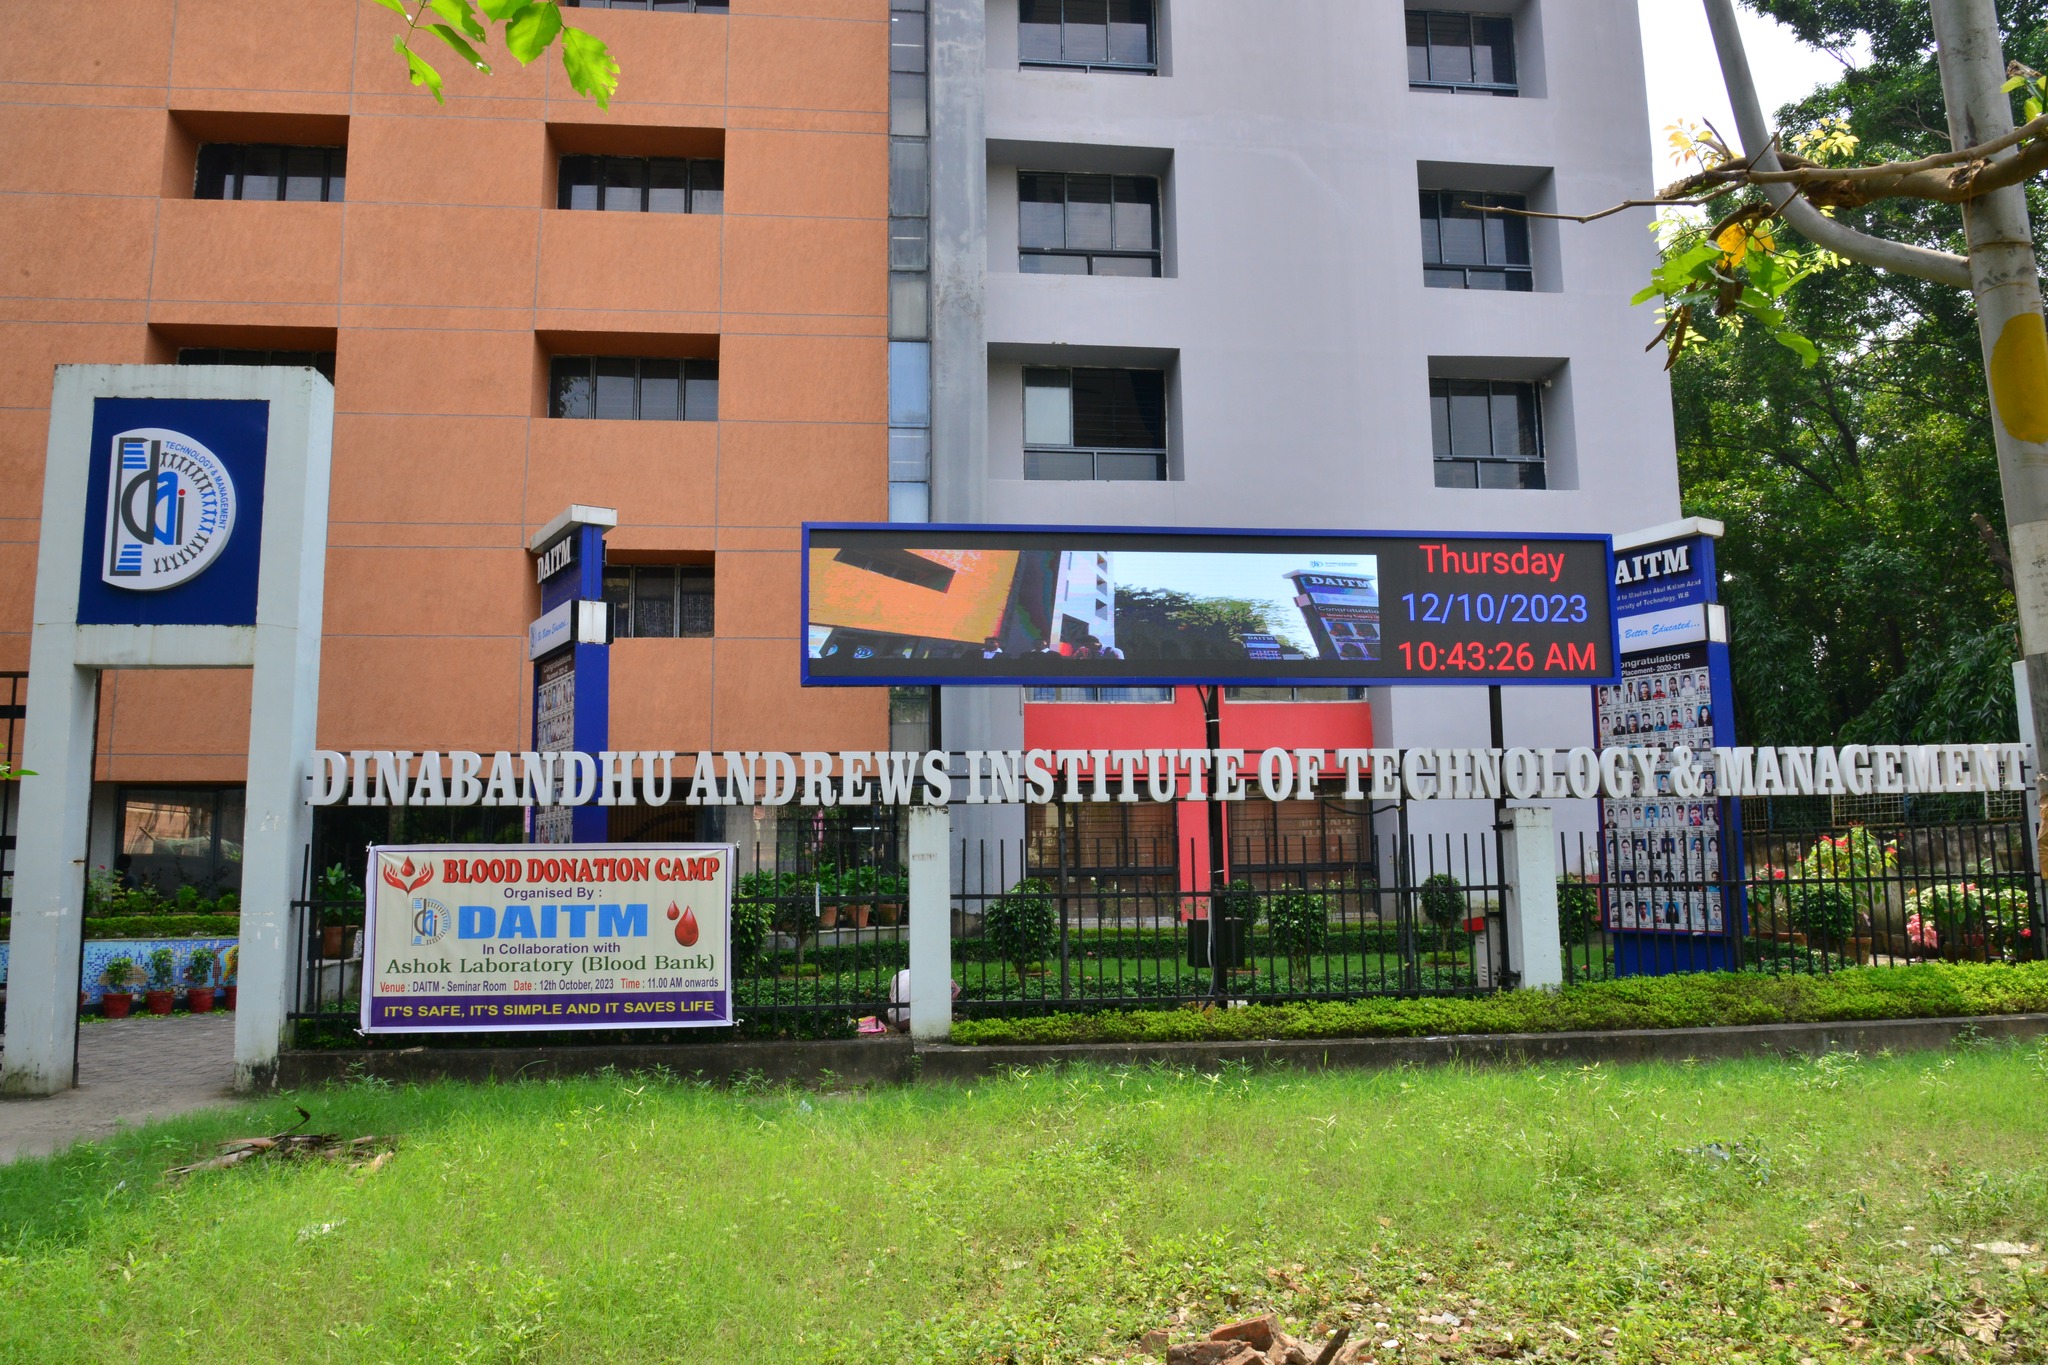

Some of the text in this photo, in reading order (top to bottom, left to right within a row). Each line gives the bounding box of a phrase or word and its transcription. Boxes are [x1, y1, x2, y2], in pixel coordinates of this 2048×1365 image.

[165, 440, 215, 469] TECHNOLOGY
[214, 475, 229, 530] MANAGEMENT
[537, 536, 572, 584] DAITM
[1419, 544, 1565, 582] Thursday
[1615, 545, 1690, 585] AITM
[1310, 576, 1369, 589] DAITM
[1628, 589, 1652, 599] Maulana
[1652, 586, 1666, 594] Abul
[1666, 583, 1686, 591] Kalam
[1686, 579, 1701, 587] Azad
[1402, 592, 1588, 624] 12/10/2023
[1617, 602, 1635, 611] versity
[1625, 620, 1700, 639] Better Educated...
[1398, 641, 1596, 671] 10:43:26 AM
[1621, 652, 1691, 670] ongratulations
[1656, 662, 1681, 671] 2020-21
[308, 743, 2028, 806] DINABANDHU ANDREWS INSTITUTE OF TECHNOLOGY & MANAGEMENT
[442, 857, 720, 883] BLOOD DONATION CAMP
[503, 887, 573, 901] Organised
[577, 887, 594, 900] By
[458, 903, 648, 939] DAITM
[482, 942, 621, 955] In Collaboration with
[385, 953, 714, 976] Ashok Laboratory (Blood Bank)
[380, 982, 405, 993] Venue
[412, 981, 440, 993] DAITM
[447, 981, 481, 992] Seminar
[483, 980, 507, 992] Room
[513, 980, 532, 991] Date
[540, 979, 556, 991] 12th
[559, 979, 593, 991] October,
[595, 979, 614, 990] 2023
[620, 978, 640, 989] Time
[647, 977, 668, 988] 11.00
[669, 977, 683, 988] AM
[685, 976, 718, 988] onwards
[384, 1000, 714, 1018] IT'S SAFE, IT'S SIMPLE AND IT SAVES LIFE
